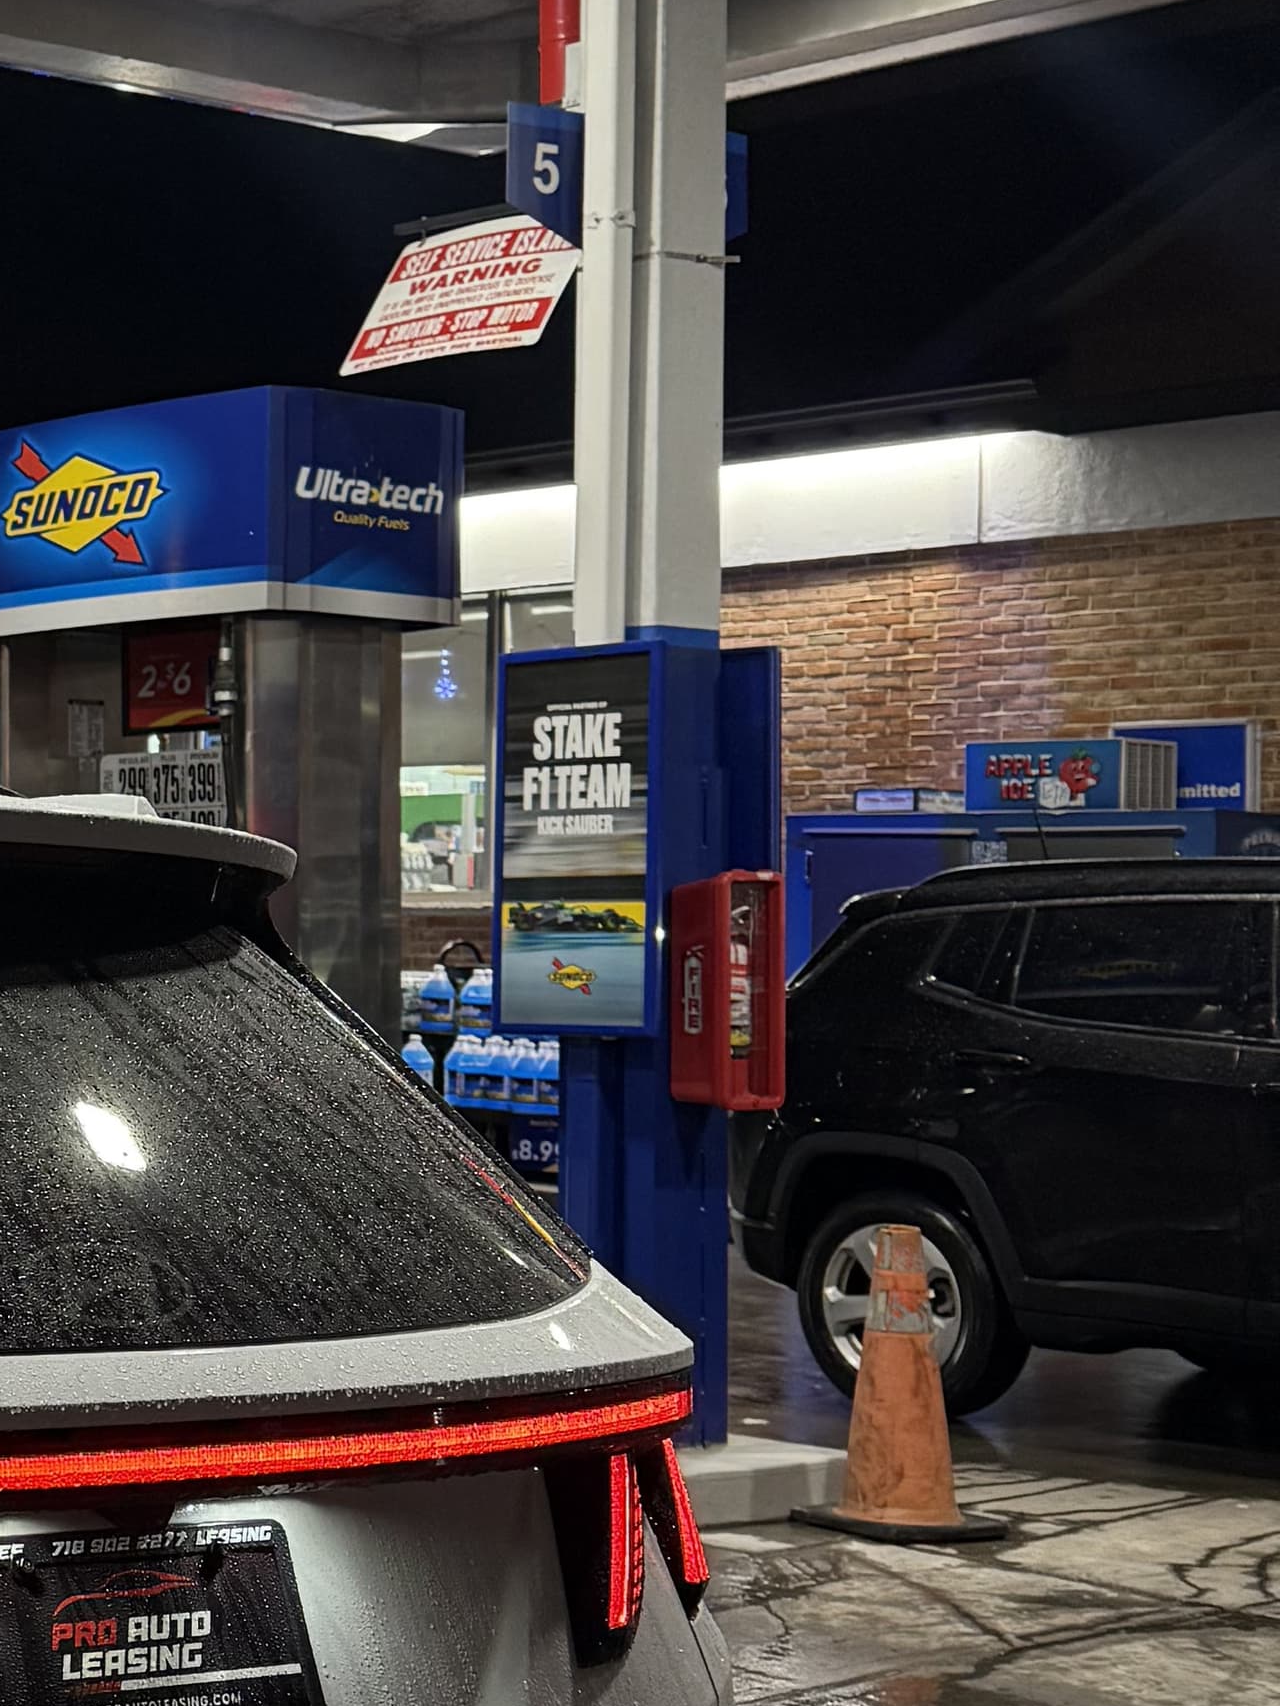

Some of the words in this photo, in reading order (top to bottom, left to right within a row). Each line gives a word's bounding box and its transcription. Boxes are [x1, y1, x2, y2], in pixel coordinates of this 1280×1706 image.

[532, 142, 560, 195] 5
[400, 248, 442, 279] SELF
[439, 232, 515, 269] SERVICE
[508, 228, 576, 256] ISLA
[409, 258, 543, 296] WARNING
[385, 315, 446, 345] SMOKING
[449, 308, 490, 332] STOP
[486, 302, 540, 327] MOTOR
[10, 476, 155, 531] SUNOCO
[333, 509, 375, 530] Quality
[377, 515, 410, 531] Fuels
[138, 665, 158, 698] 2
[532, 712, 622, 761] STAKE
[153, 764, 180, 804] 375
[188, 763, 216, 803] 399
[985, 754, 1053, 778] APPLE
[522, 765, 552, 811] F1
[554, 762, 631, 810] TEAM
[1001, 778, 1035, 800] ICE
[537, 815, 564, 836] KICK
[565, 814, 614, 835] SAUBER
[550, 972, 594, 983] SUNOCO
[689, 966, 700, 1028] FIRE
[51, 1540, 85, 1557] 718
[51, 1617, 118, 1651] PRO
[127, 1610, 211, 1644] AUTO
[61, 1643, 203, 1681] LEASING
